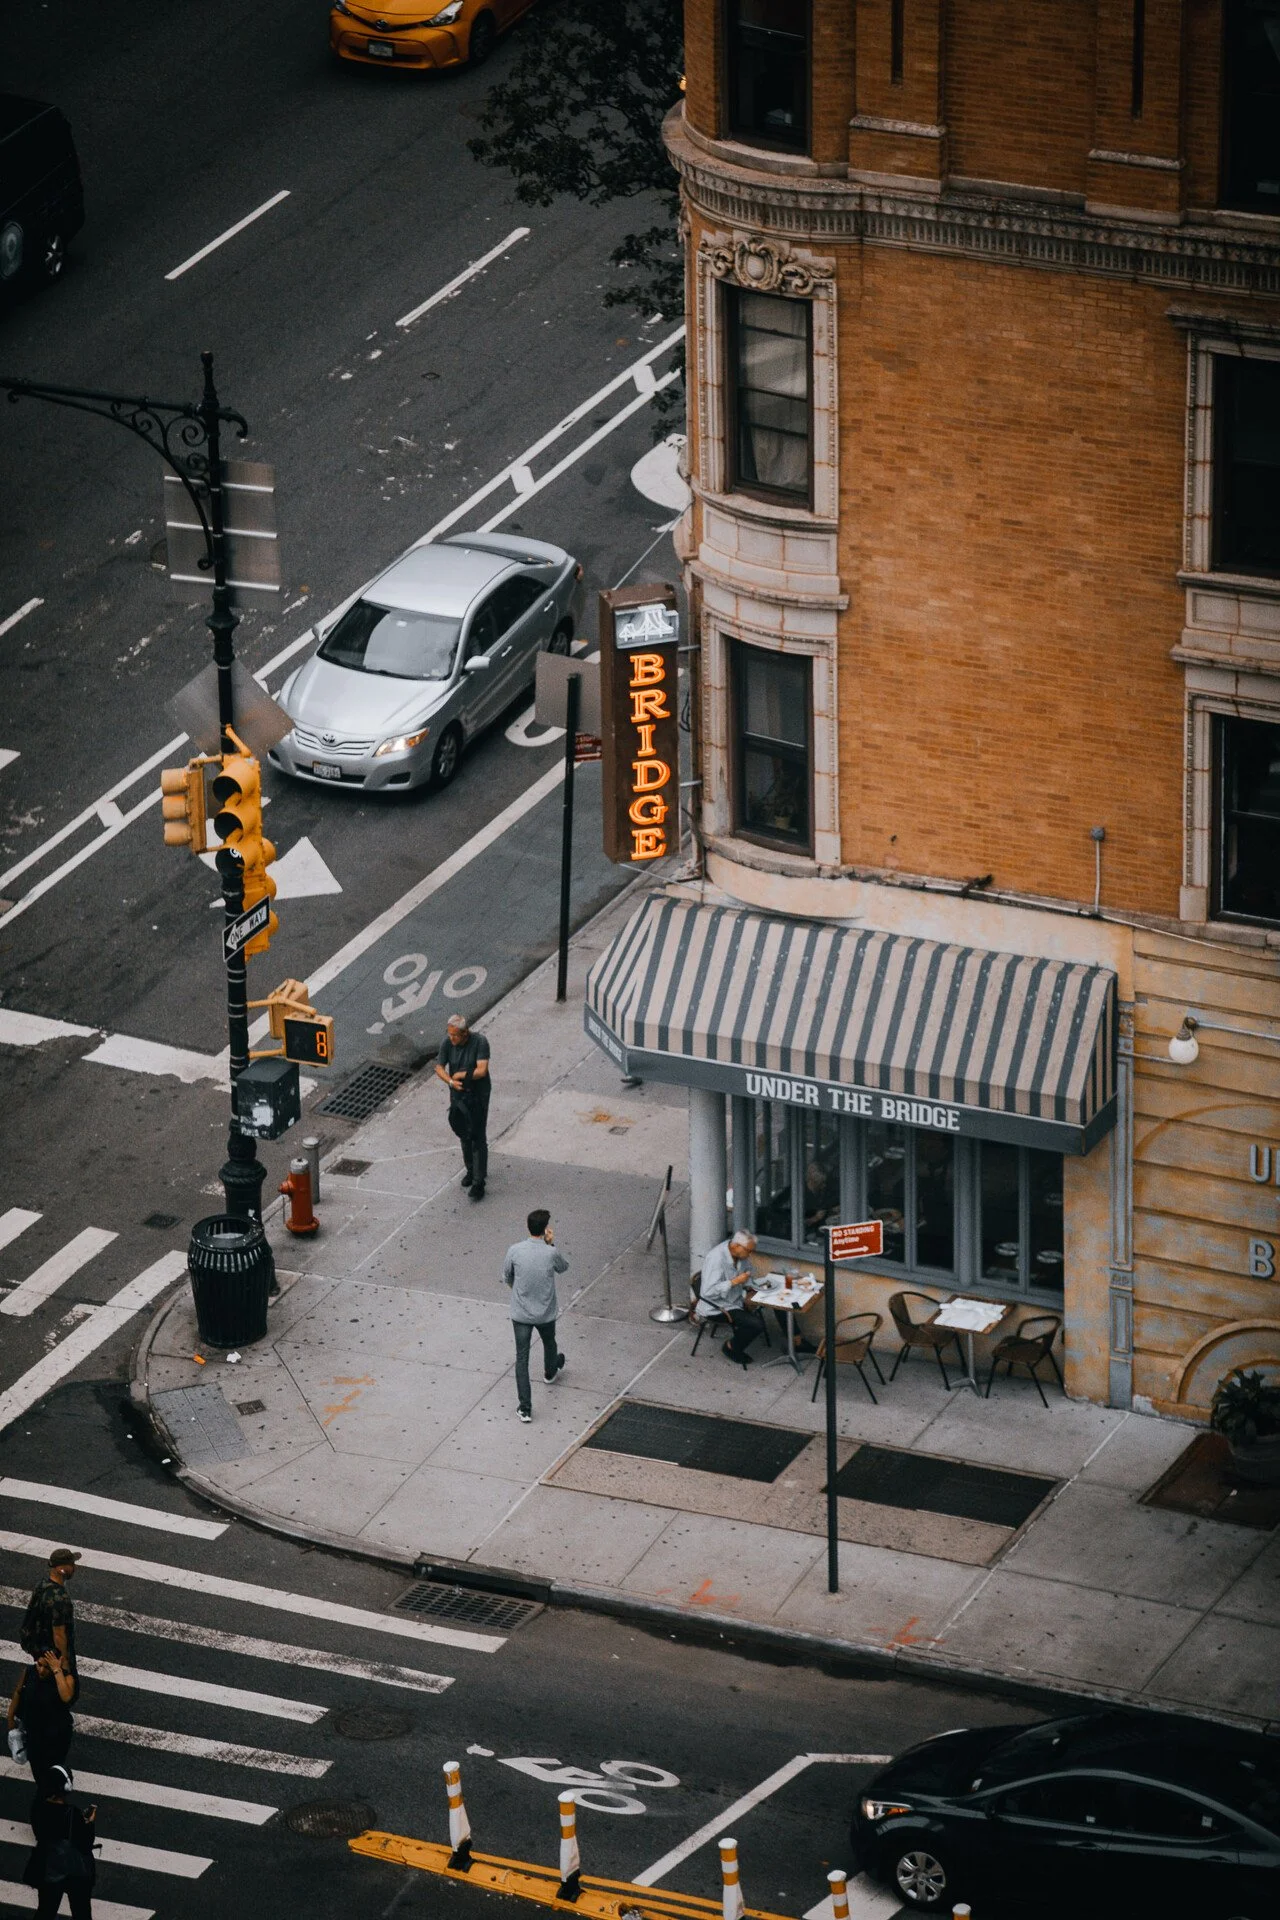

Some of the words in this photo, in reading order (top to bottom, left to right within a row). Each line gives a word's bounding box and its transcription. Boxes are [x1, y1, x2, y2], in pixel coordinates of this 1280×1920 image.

[628, 653, 671, 860] BRIDGE
[248, 908, 264, 930] WAY
[745, 1073, 820, 1106] UNDER
[827, 1087, 873, 1116] THE
[880, 1097, 960, 1131] BRIDGE
[833, 1236, 860, 1244] Anytime
[843, 1225, 875, 1236] STANDING
